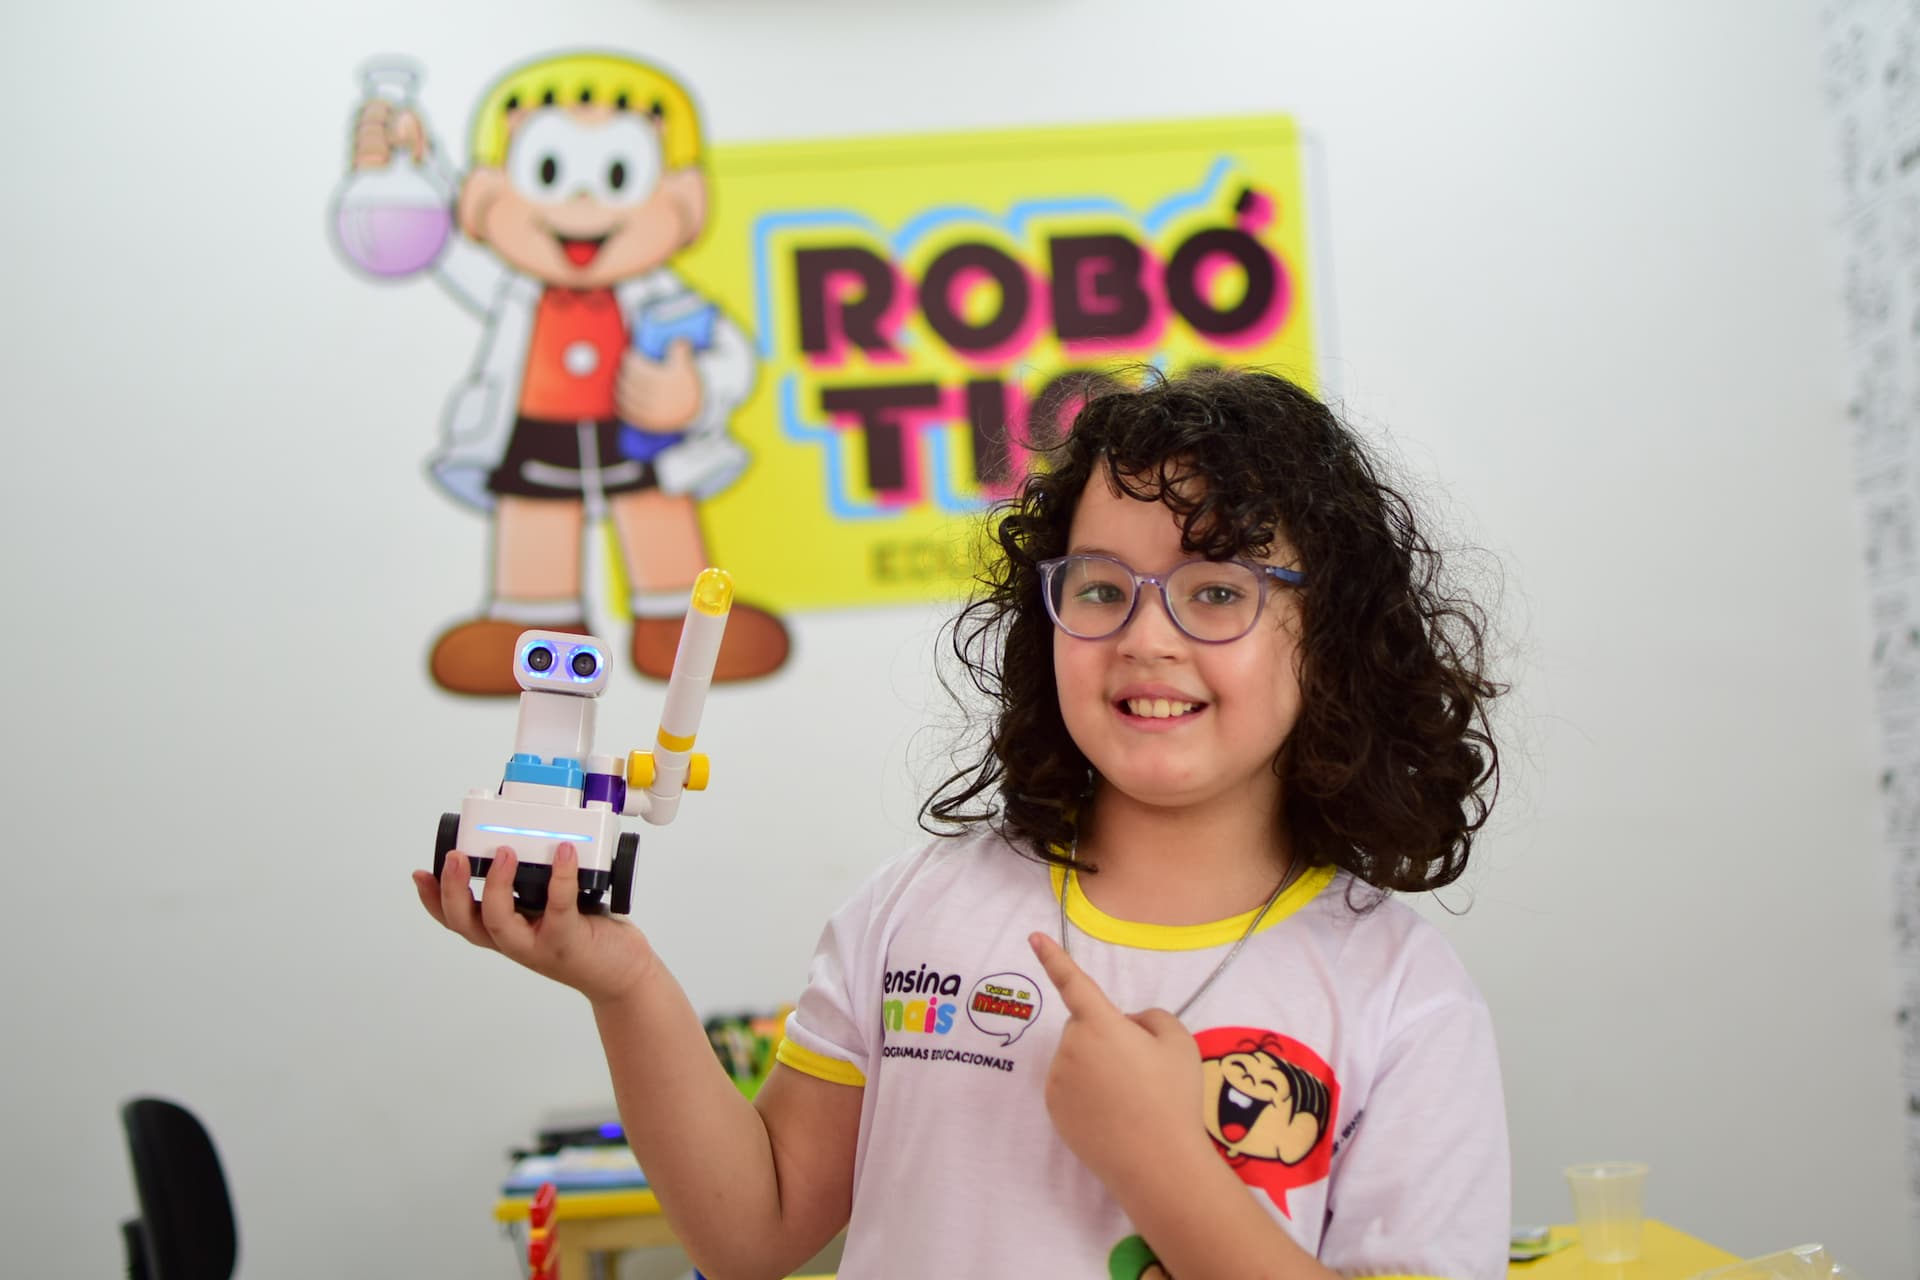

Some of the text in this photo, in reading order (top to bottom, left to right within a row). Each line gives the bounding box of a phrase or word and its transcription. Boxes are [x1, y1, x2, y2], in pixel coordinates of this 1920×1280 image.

[792, 187, 1288, 364] ROBÓ
[884, 963, 961, 996] ensina
[931, 1049, 1014, 1072] EDUCACIONAIS
